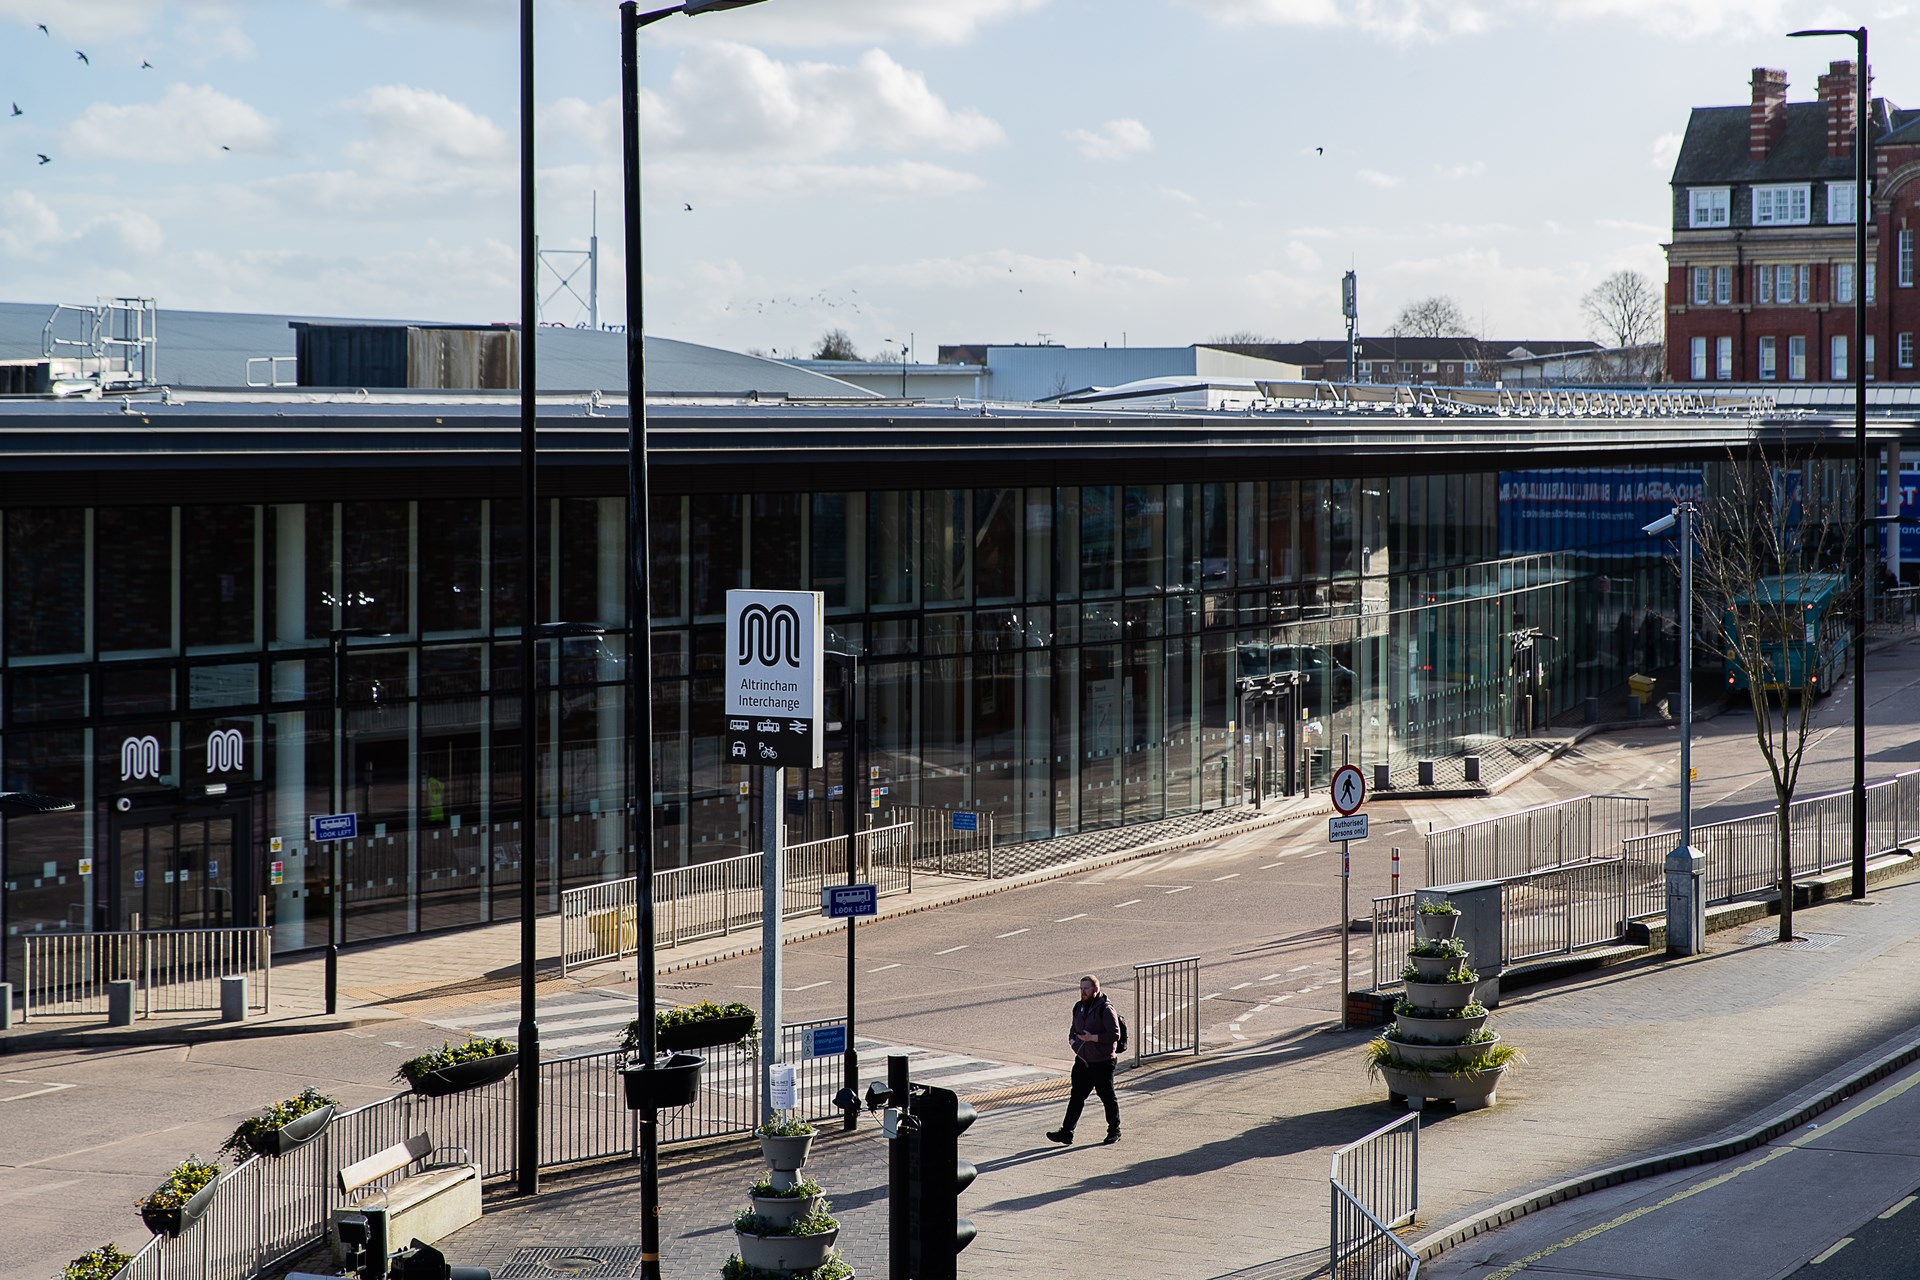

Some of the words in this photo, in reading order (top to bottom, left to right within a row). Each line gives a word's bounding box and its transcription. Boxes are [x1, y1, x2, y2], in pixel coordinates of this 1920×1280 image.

[740, 678, 798, 692] Altrincham
[738, 695, 800, 711] Interchange
[758, 741, 765, 751] P
[1333, 818, 1364, 829] Authorised
[1331, 830, 1353, 839] persons
[1354, 827, 1366, 835] only
[834, 905, 853, 914] LOOK
[855, 904, 871, 912] LEFT
